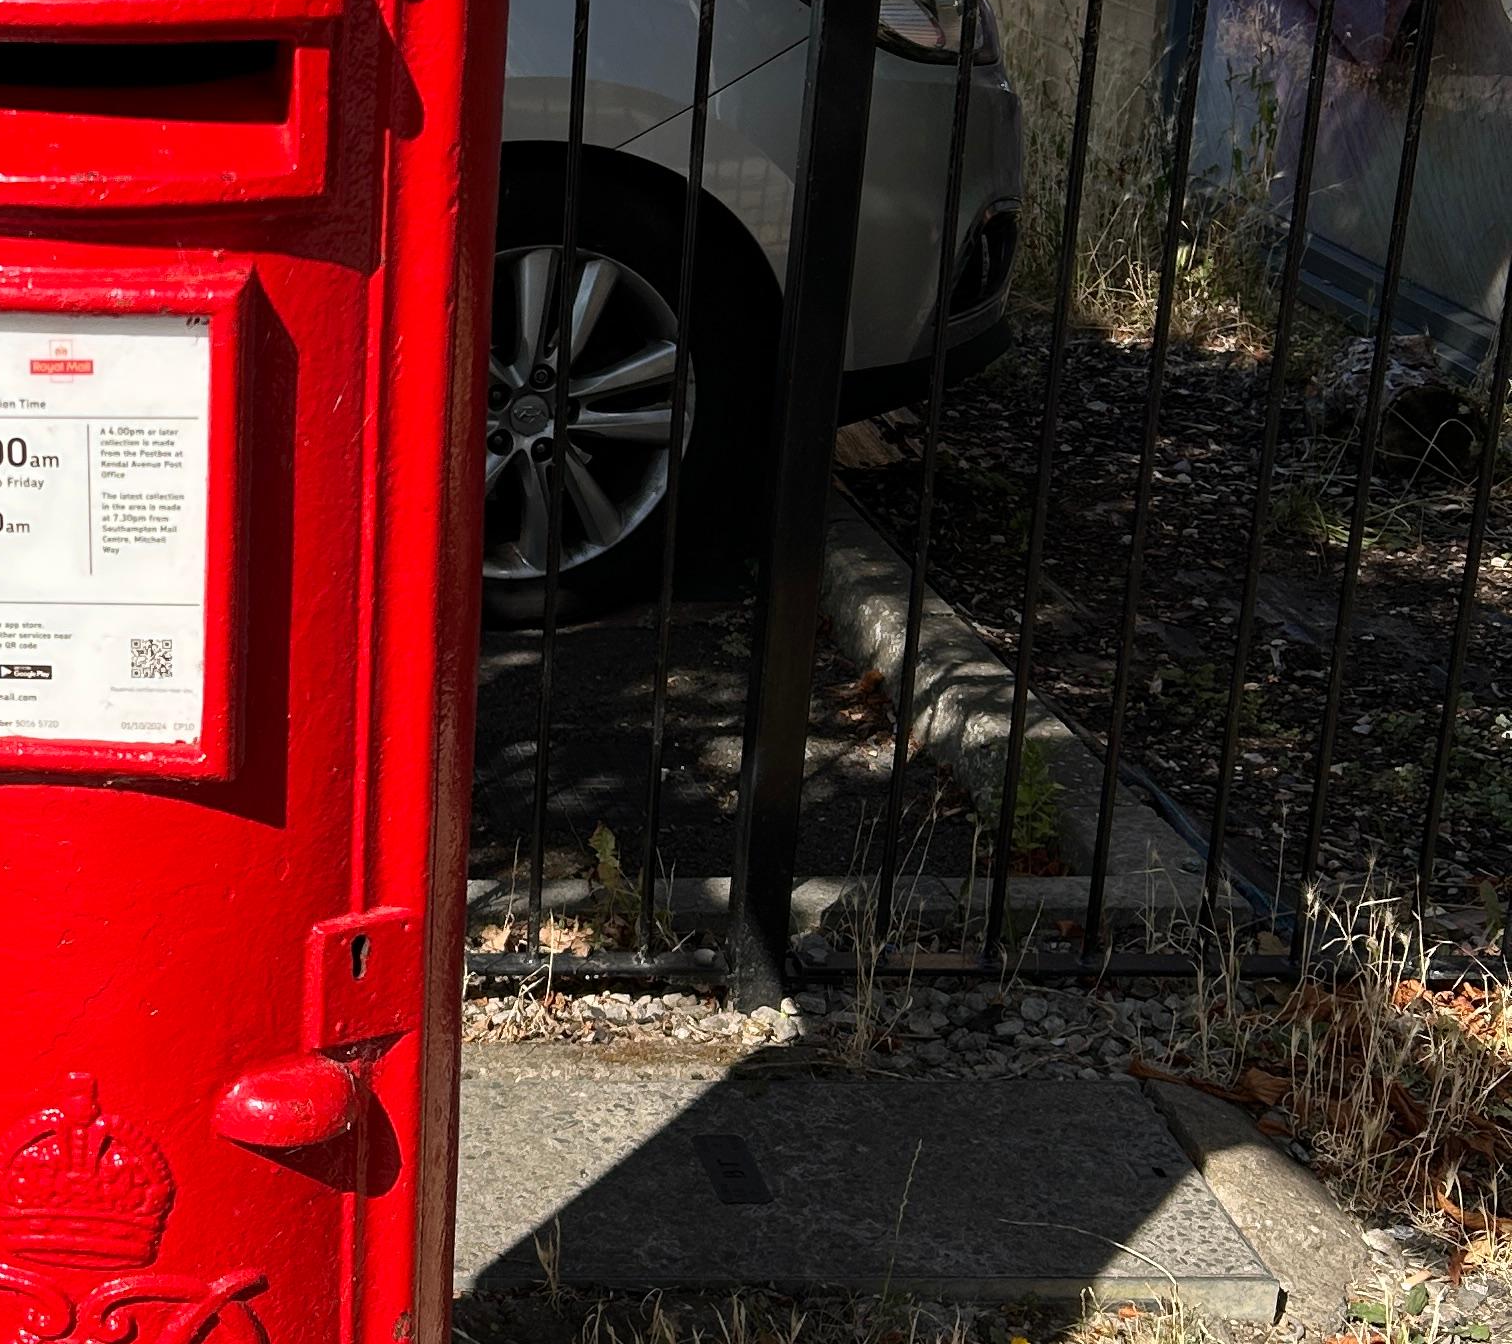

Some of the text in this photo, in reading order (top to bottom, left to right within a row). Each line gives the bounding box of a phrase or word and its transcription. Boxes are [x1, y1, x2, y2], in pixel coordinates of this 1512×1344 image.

[19, 398, 46, 409] Time
[7, 476, 45, 490] Friday
[4, 621, 19, 630] app
[18, 632, 51, 640] services
[4, 641, 17, 649] QR
[18, 641, 38, 650] code
